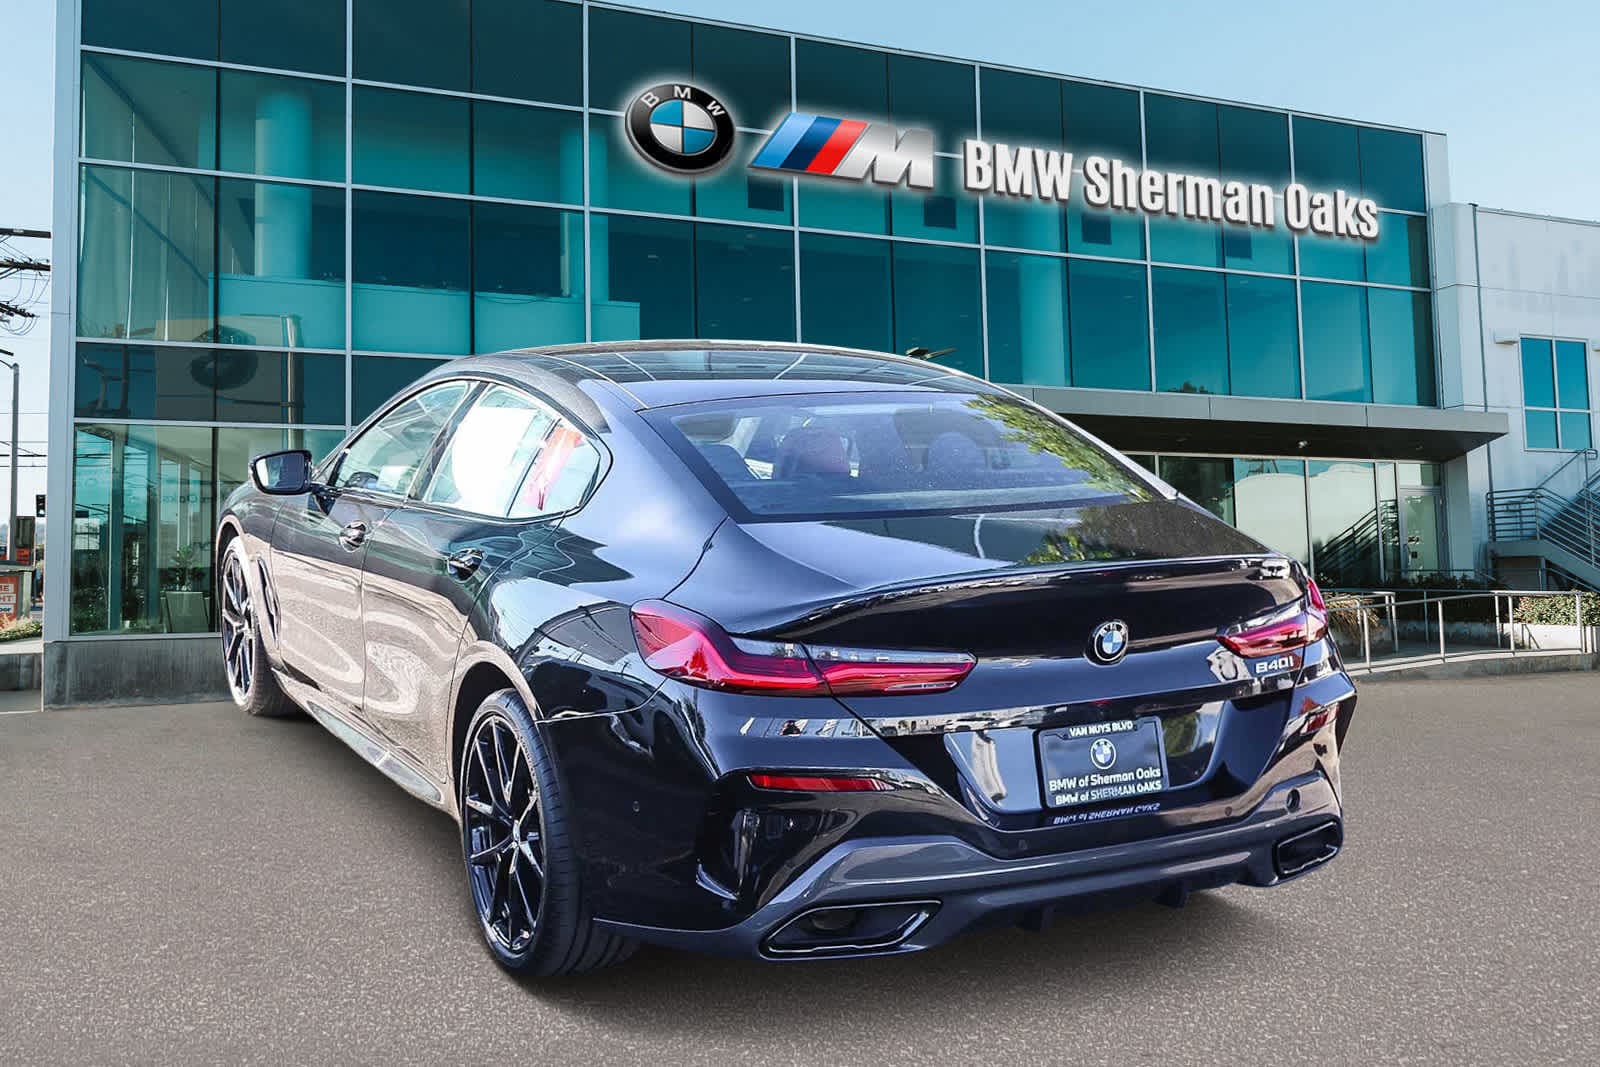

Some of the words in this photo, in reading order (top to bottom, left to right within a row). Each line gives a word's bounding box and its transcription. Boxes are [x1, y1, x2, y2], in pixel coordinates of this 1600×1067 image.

[641, 84, 726, 117] BMW
[963, 138, 1074, 202] BMW
[1083, 155, 1275, 228] Sherman
[1284, 182, 1380, 241] Oaks
[1069, 727, 1088, 737] VAN
[1089, 723, 1112, 735] NUYS
[1112, 720, 1134, 732] BLVD
[1049, 777, 1077, 792] BMW
[1079, 775, 1089, 787] of
[1090, 771, 1135, 787] Sherman
[1136, 767, 1161, 780] Oaks
[1055, 792, 1079, 806] BMW
[1080, 791, 1090, 802] of
[1091, 784, 1136, 800] SHERMAN
[1136, 780, 1162, 793] OAKS
